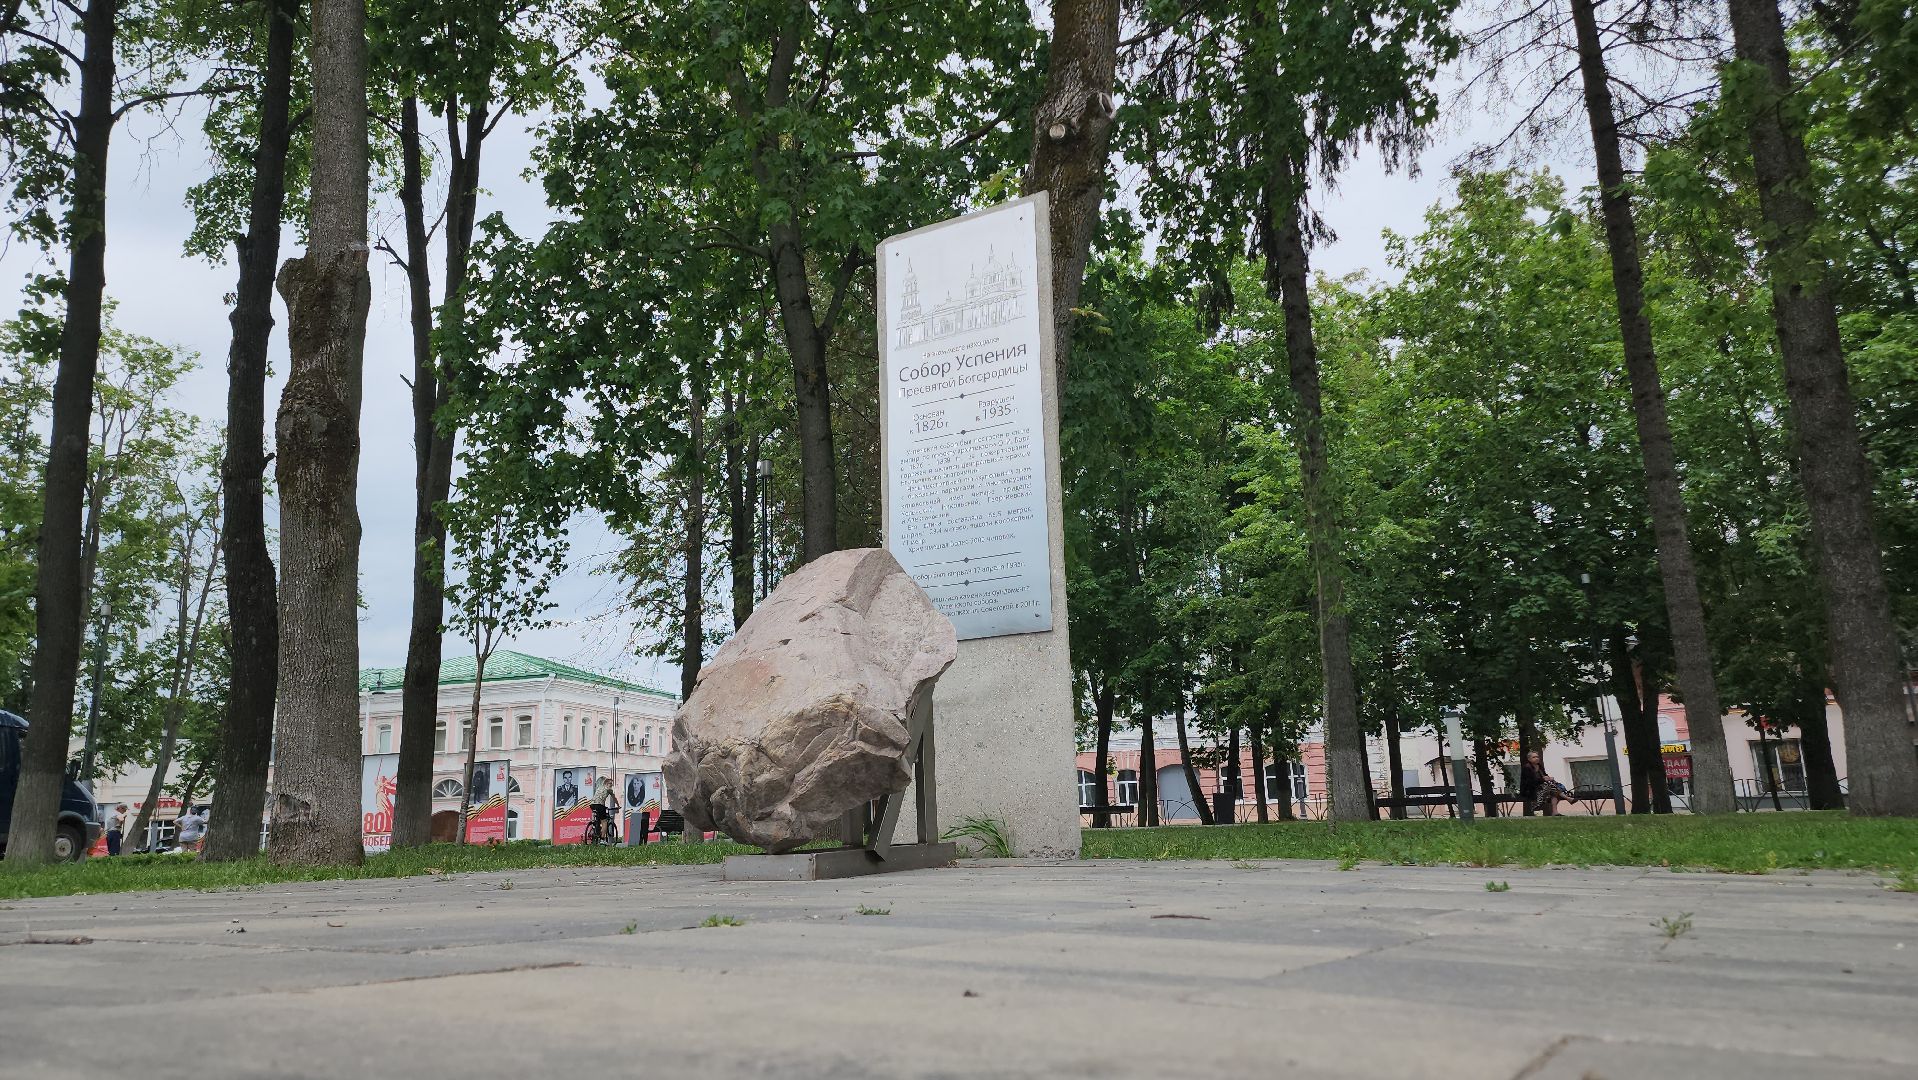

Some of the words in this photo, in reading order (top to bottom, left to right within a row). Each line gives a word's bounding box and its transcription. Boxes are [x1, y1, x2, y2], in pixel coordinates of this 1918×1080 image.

[899, 361, 951, 382] Собор
[956, 343, 1027, 371] Успения
[899, 377, 956, 399] Пресвятой
[958, 363, 1028, 386] Богородицы
[913, 409, 945, 422] Основан
[982, 404, 1012, 420] 1935
[915, 418, 944, 433] 1826
[363, 812, 384, 833] 80
[362, 835, 391, 847] ПОБЕД
